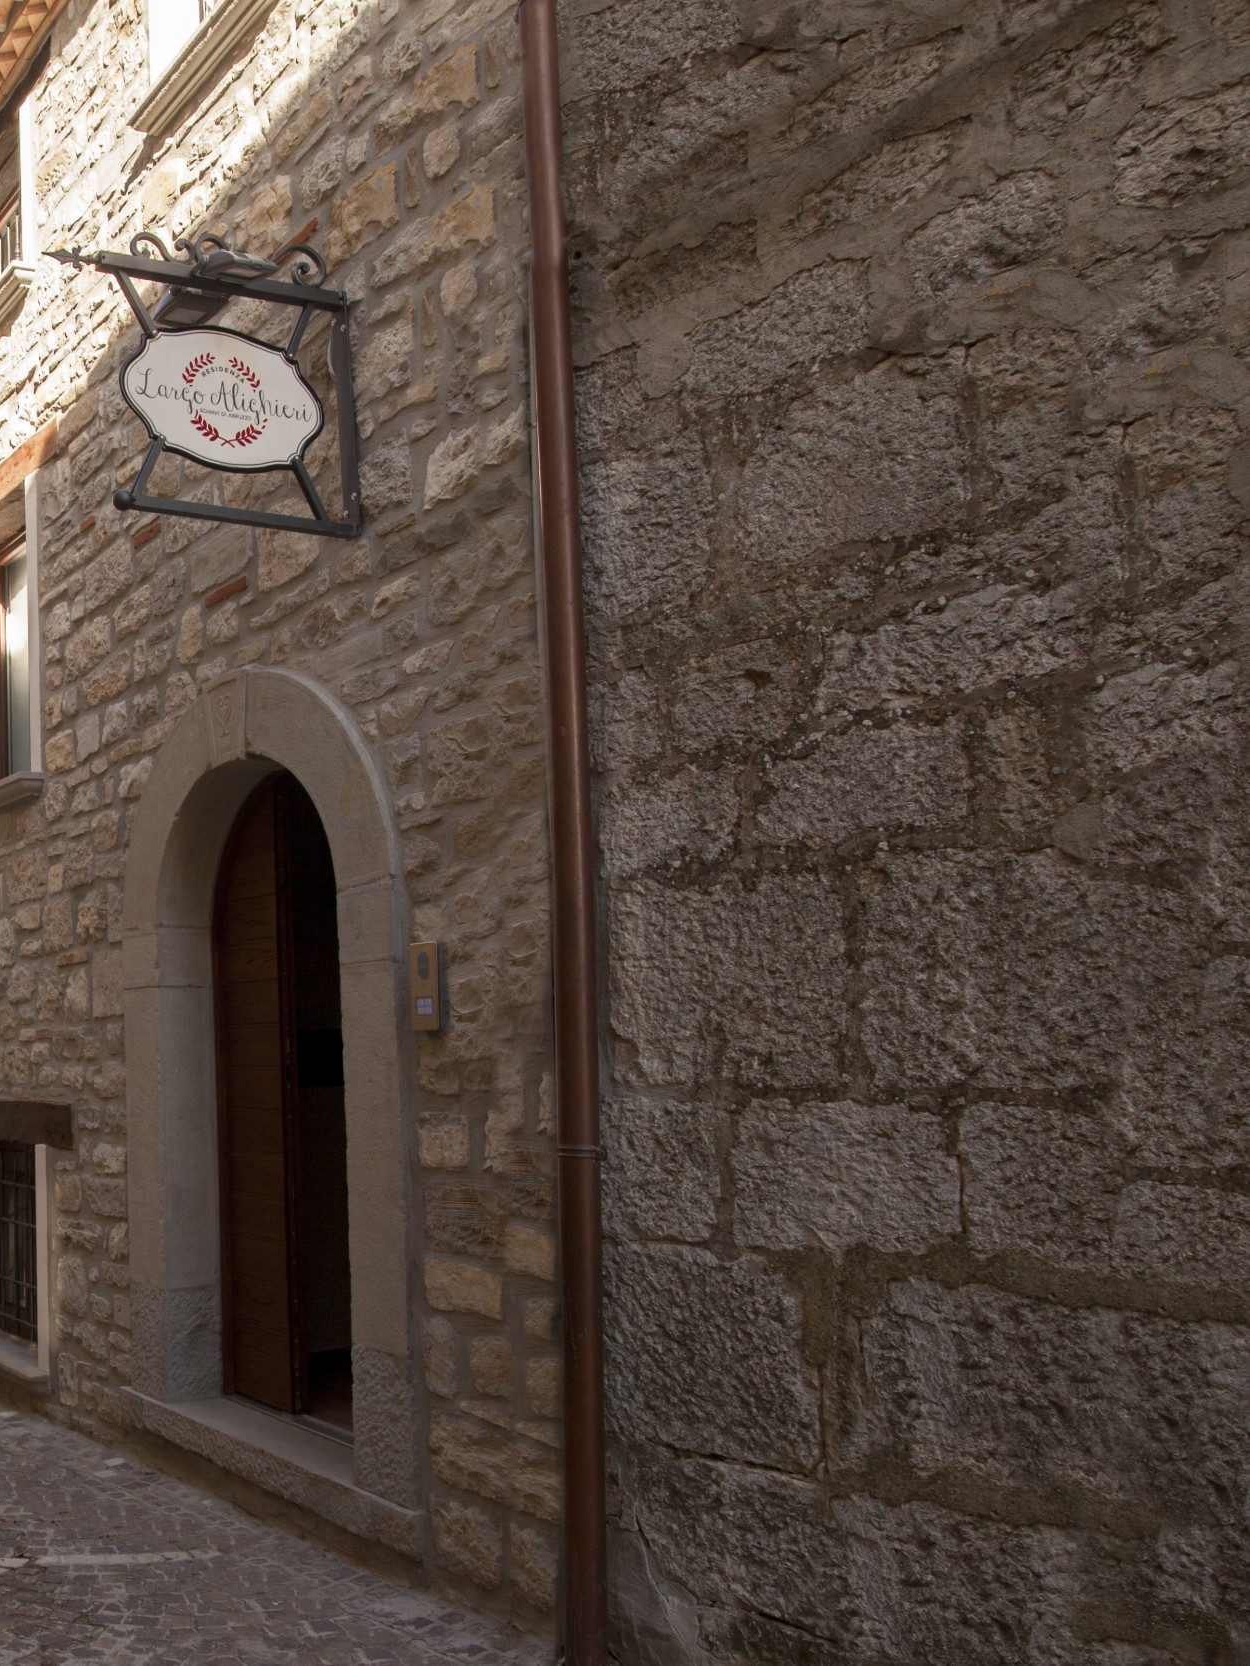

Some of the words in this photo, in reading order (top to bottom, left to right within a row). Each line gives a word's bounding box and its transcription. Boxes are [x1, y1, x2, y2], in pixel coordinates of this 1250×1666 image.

[201, 366, 245, 384] RESIDENZA
[135, 367, 207, 415] Largo
[210, 380, 313, 426] Alighieri
[199, 408, 220, 416] SCHIAVI
[228, 413, 252, 421] ABRUZZO
